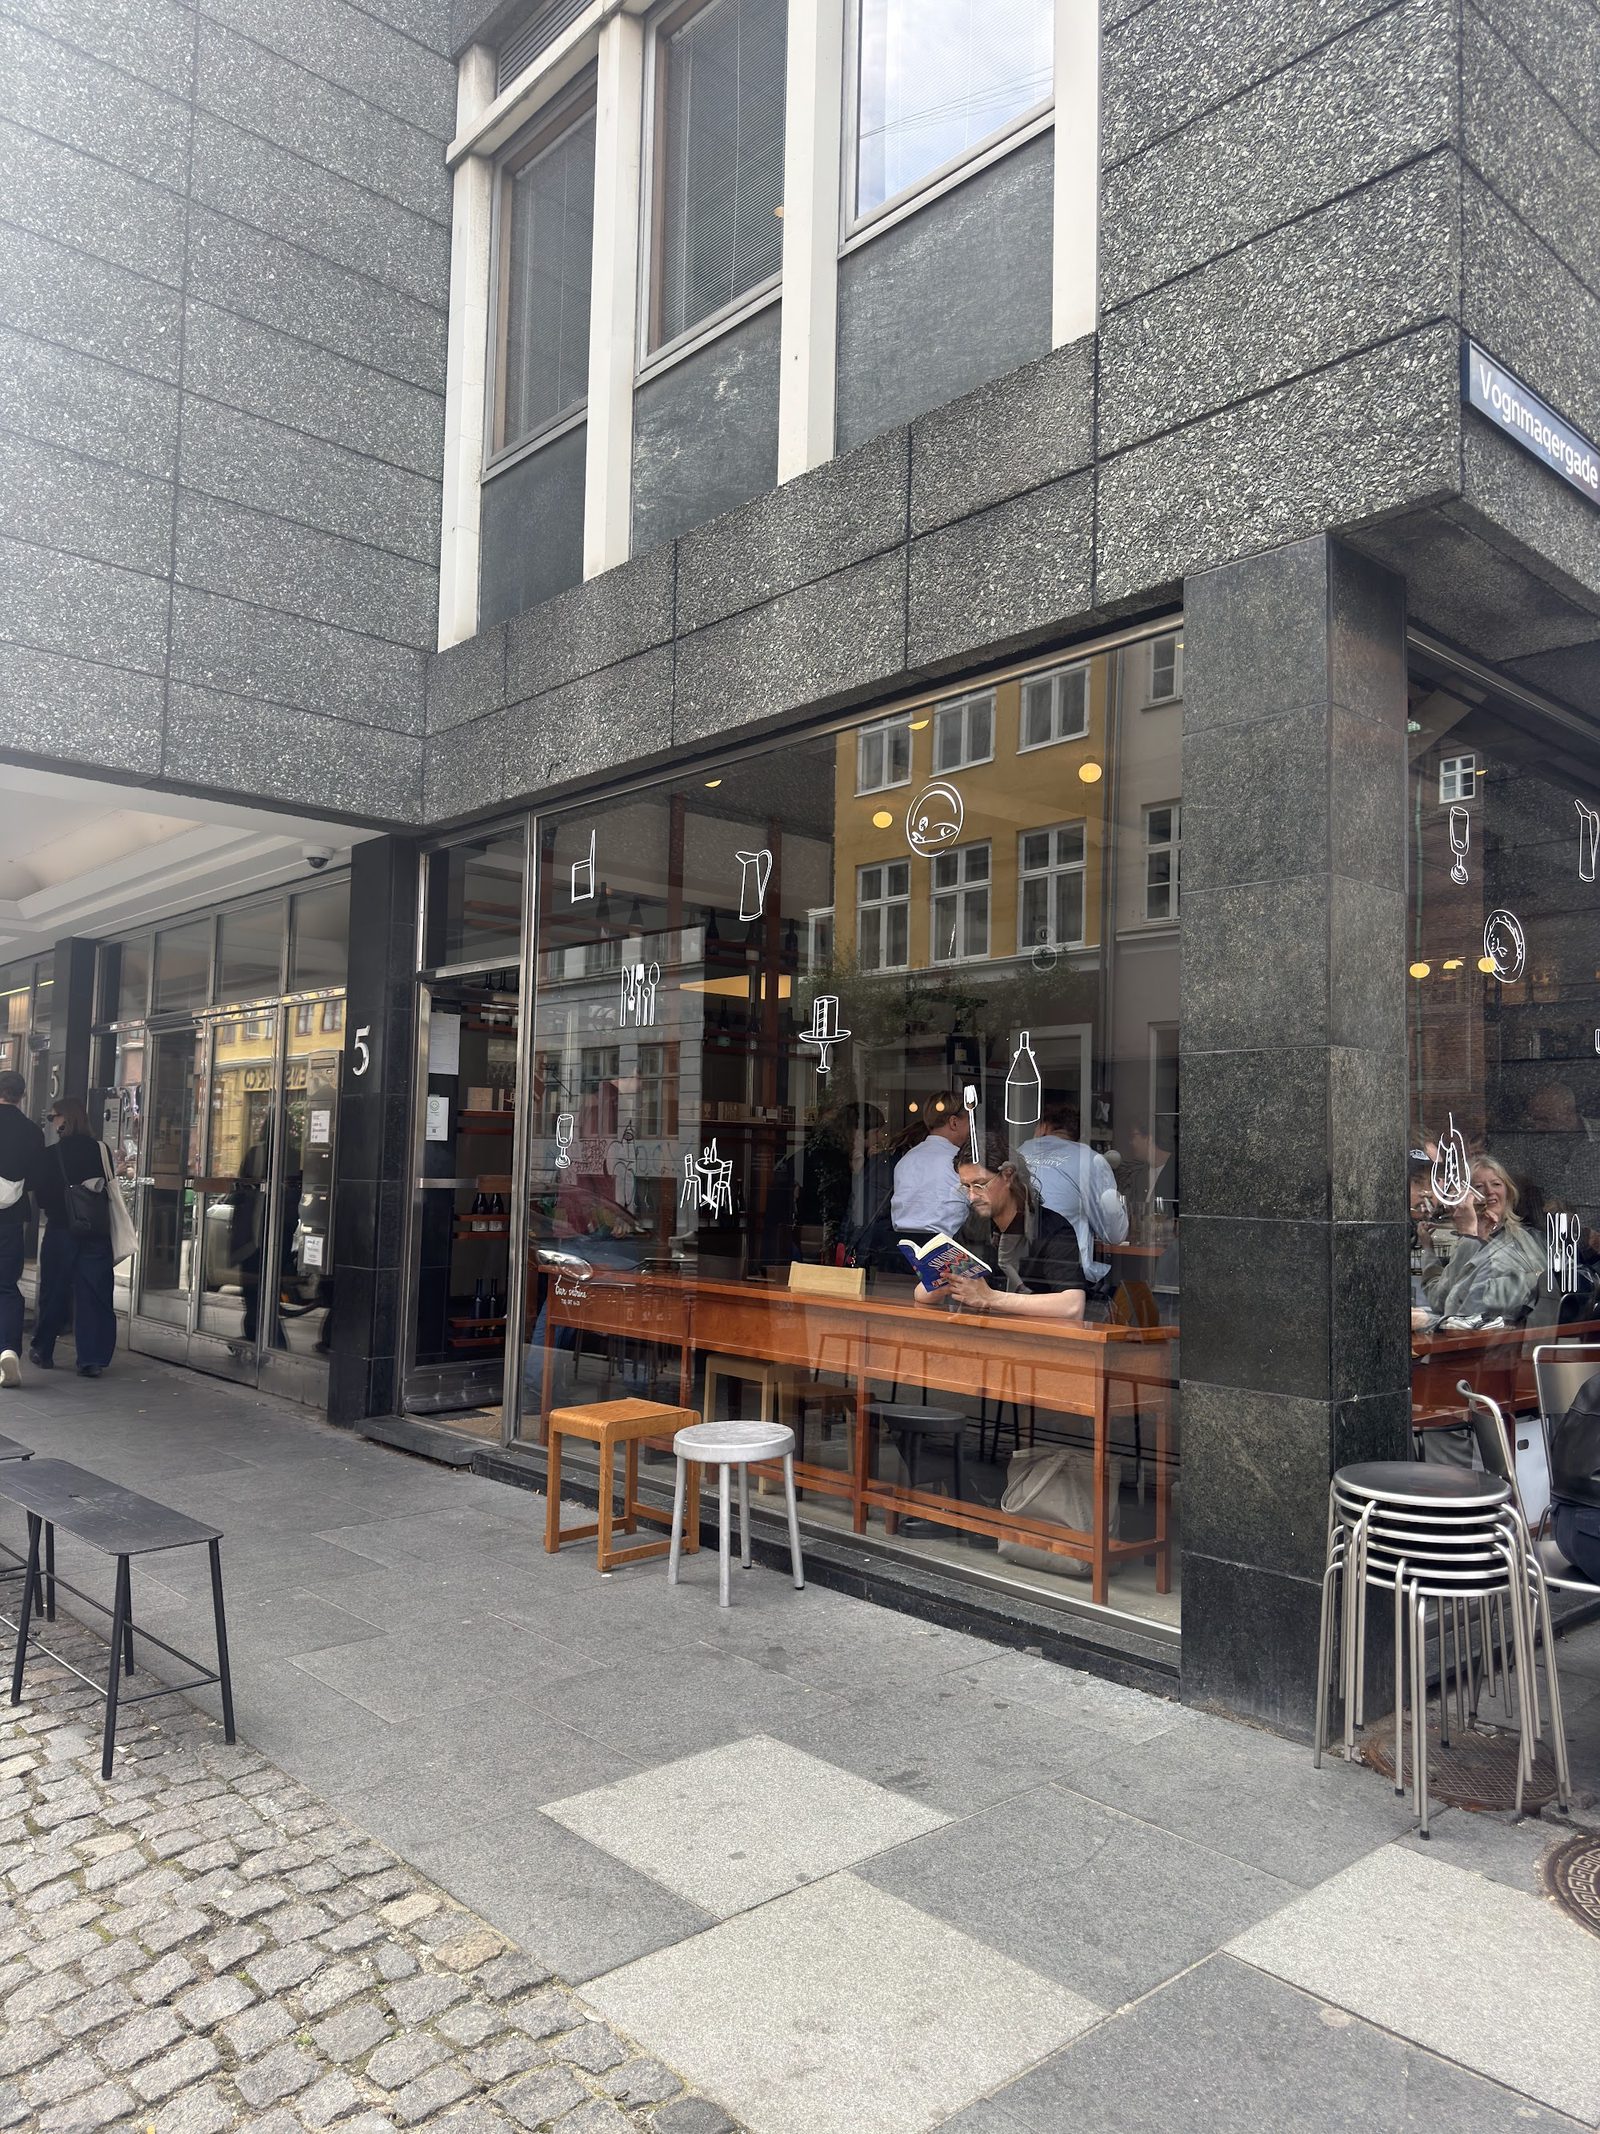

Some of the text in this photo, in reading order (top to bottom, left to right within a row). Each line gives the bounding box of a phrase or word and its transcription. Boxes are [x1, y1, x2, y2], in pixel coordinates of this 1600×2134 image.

[1479, 363, 1598, 489] Vognmagergade
[352, 1024, 371, 1076] 5
[50, 1064, 60, 1099] 5
